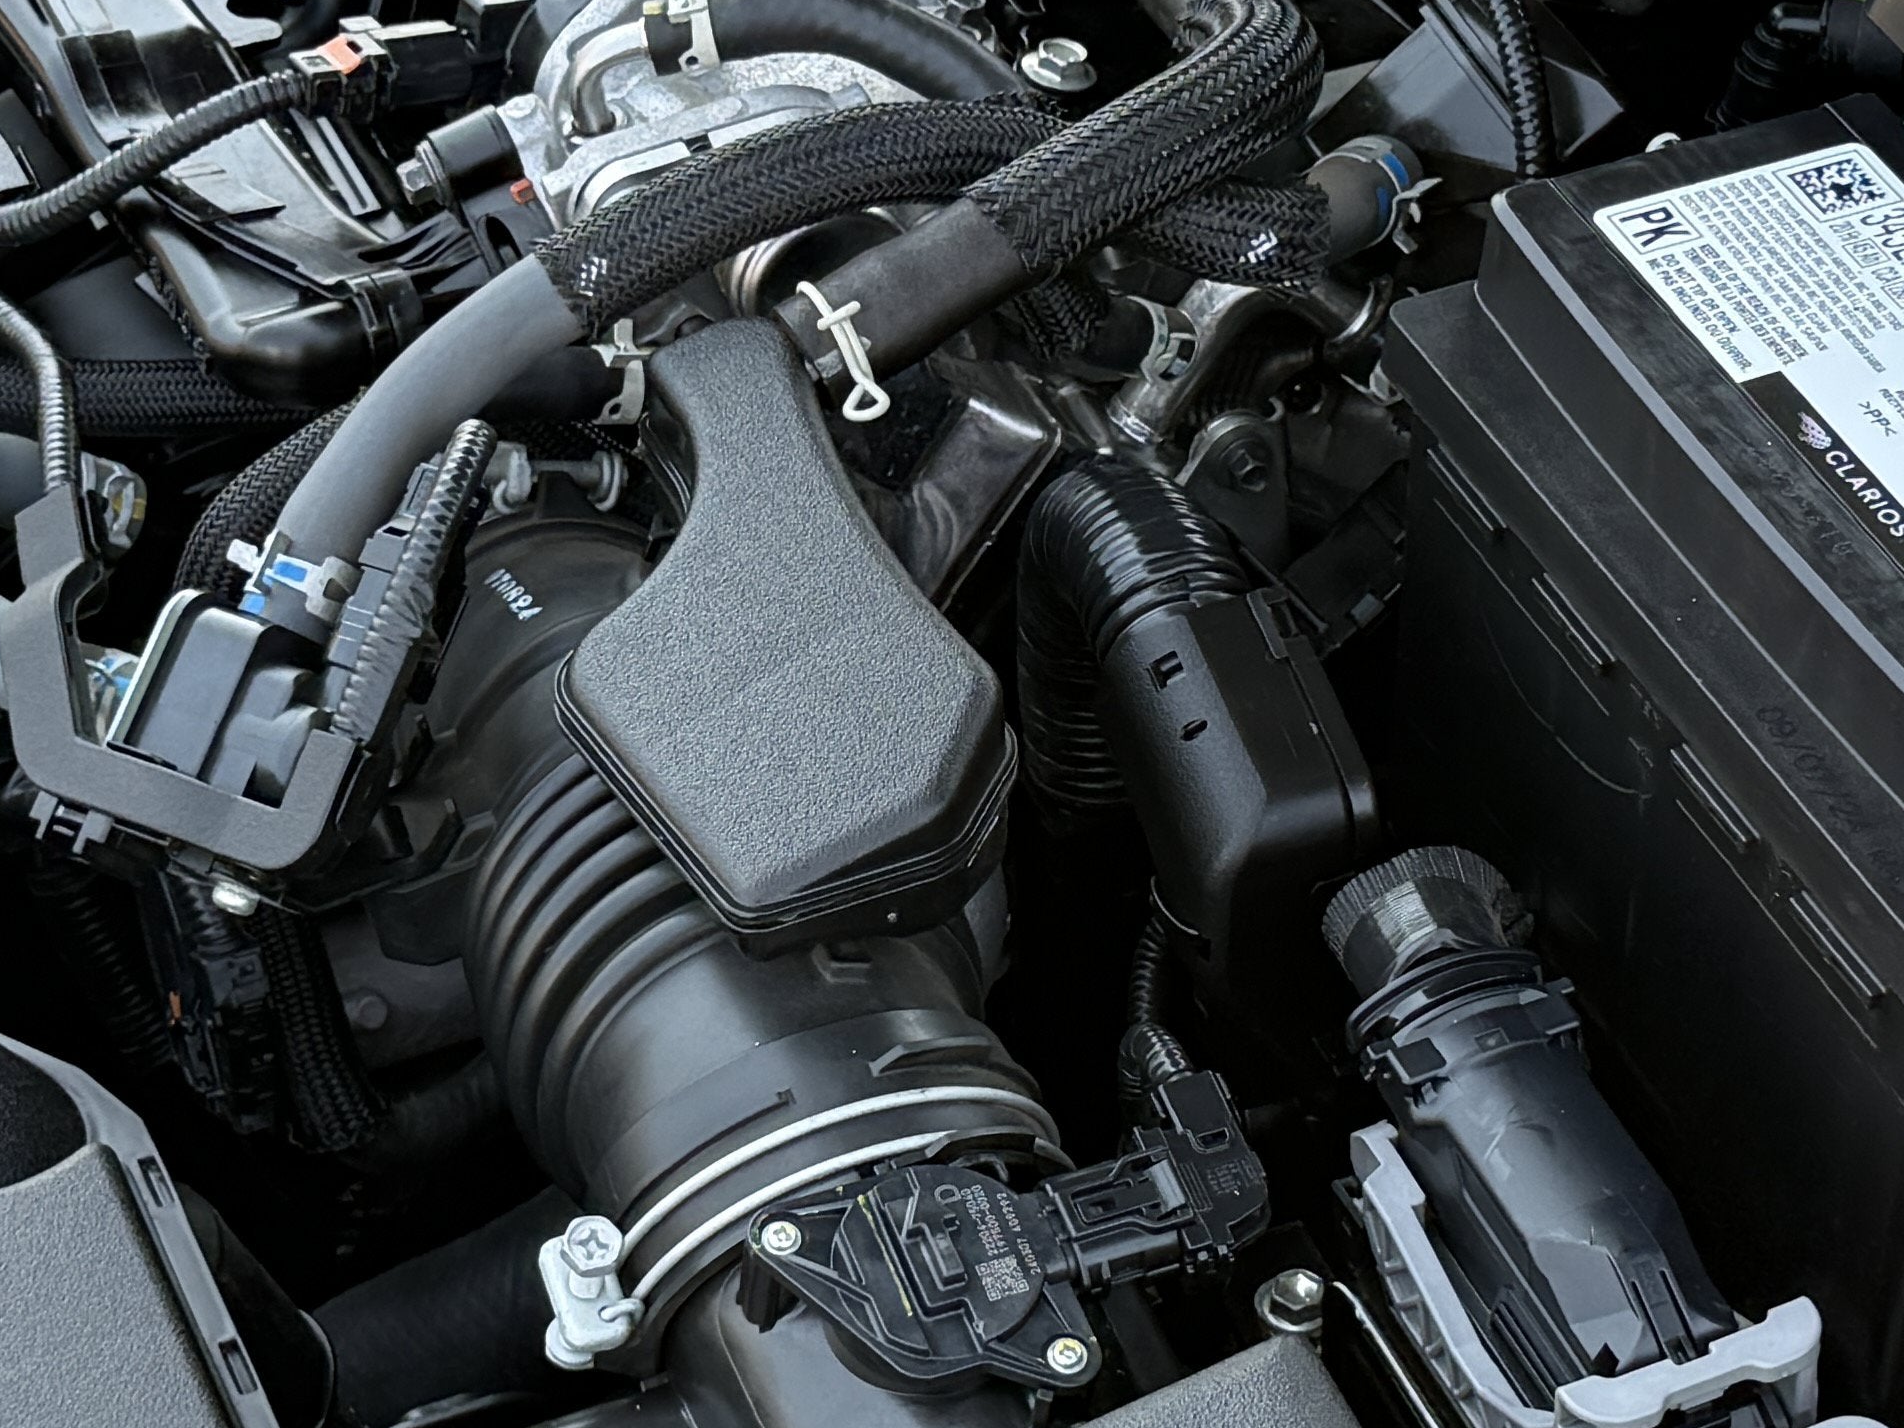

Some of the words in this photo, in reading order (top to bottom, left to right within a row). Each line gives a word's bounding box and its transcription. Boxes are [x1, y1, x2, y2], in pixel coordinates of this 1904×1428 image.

[1620, 207, 1690, 246] PK
[1646, 258, 1663, 270] NE
[1657, 270, 1678, 286] PAS
[1705, 324, 1723, 337] OU
[1661, 254, 1680, 267] DO
[1674, 267, 1696, 283] NOT
[1689, 284, 1708, 297] TIP
[1701, 298, 1720, 311] OR
